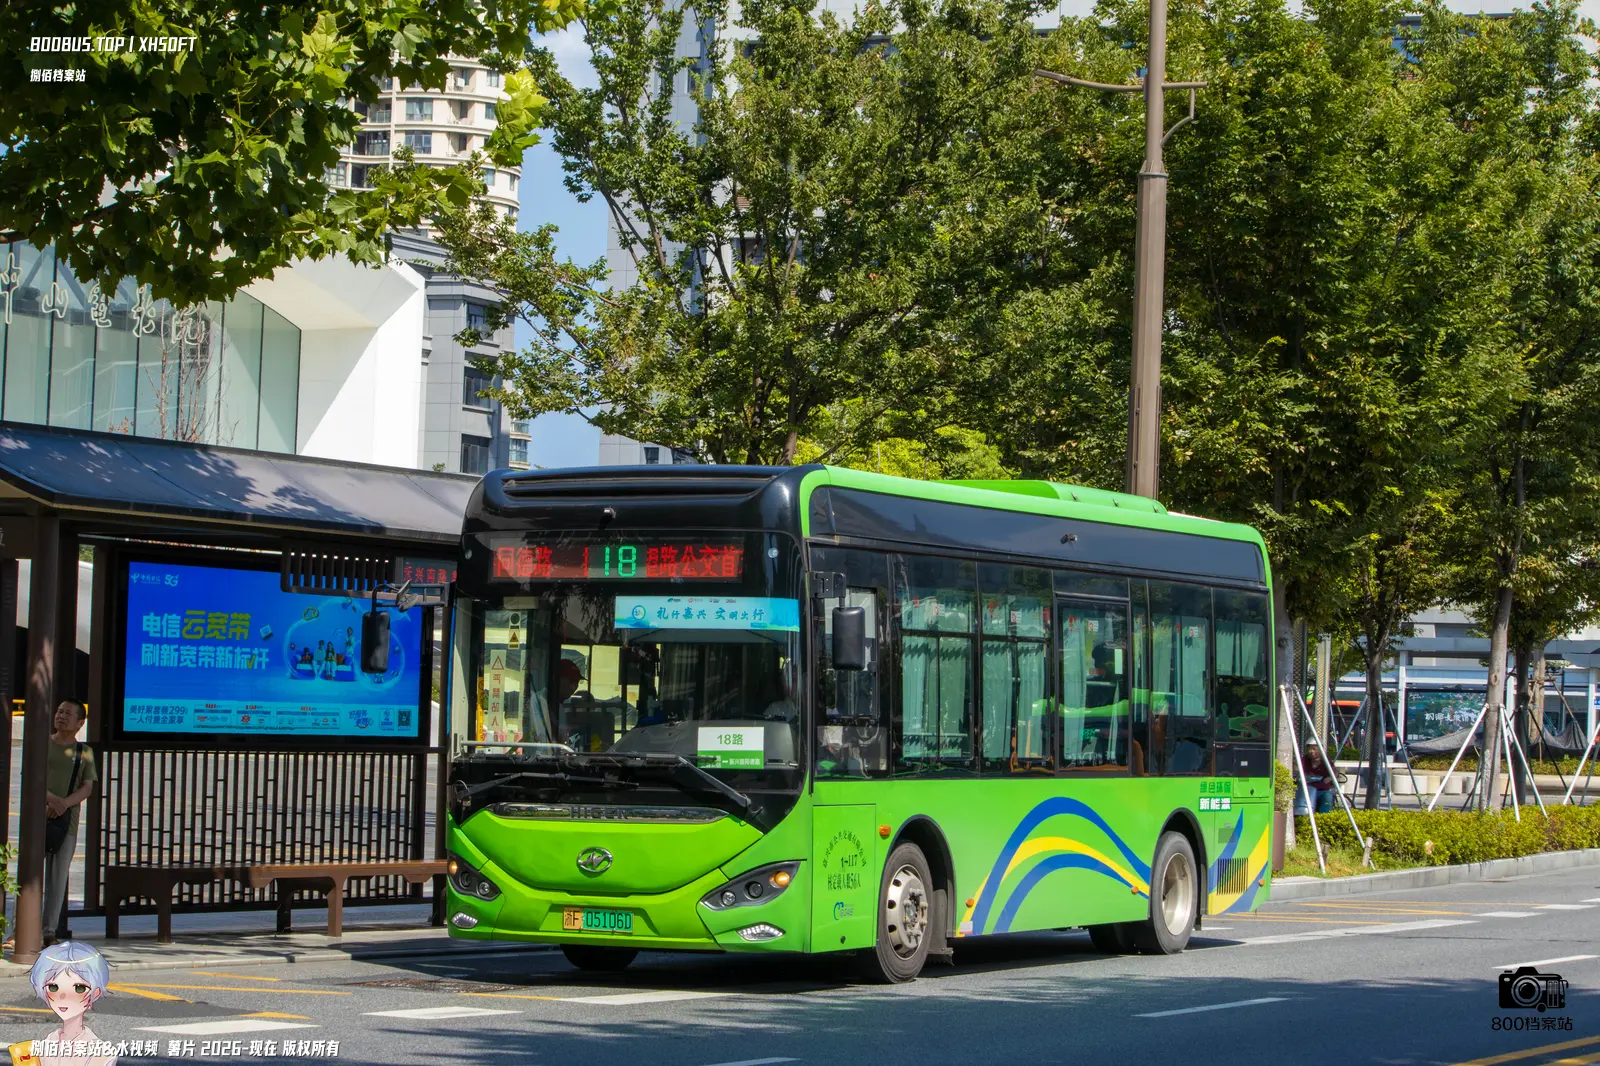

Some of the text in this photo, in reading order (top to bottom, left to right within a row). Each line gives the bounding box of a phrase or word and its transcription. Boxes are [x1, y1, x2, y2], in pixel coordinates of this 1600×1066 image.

[493, 546, 552, 577] 同德路
[604, 545, 637, 578] 18
[646, 546, 744, 578] 路公交首
[164, 574, 180, 587] 5G
[142, 609, 251, 640] 电信云宽带
[141, 643, 269, 669] 刷新宽带新标杆
[717, 733, 744, 745] 18路
[1200, 781, 1231, 793] 绿色环保
[1199, 797, 1231, 810] 新能源
[570, 806, 628, 820] HIGER
[585, 911, 632, 930] 05106D
